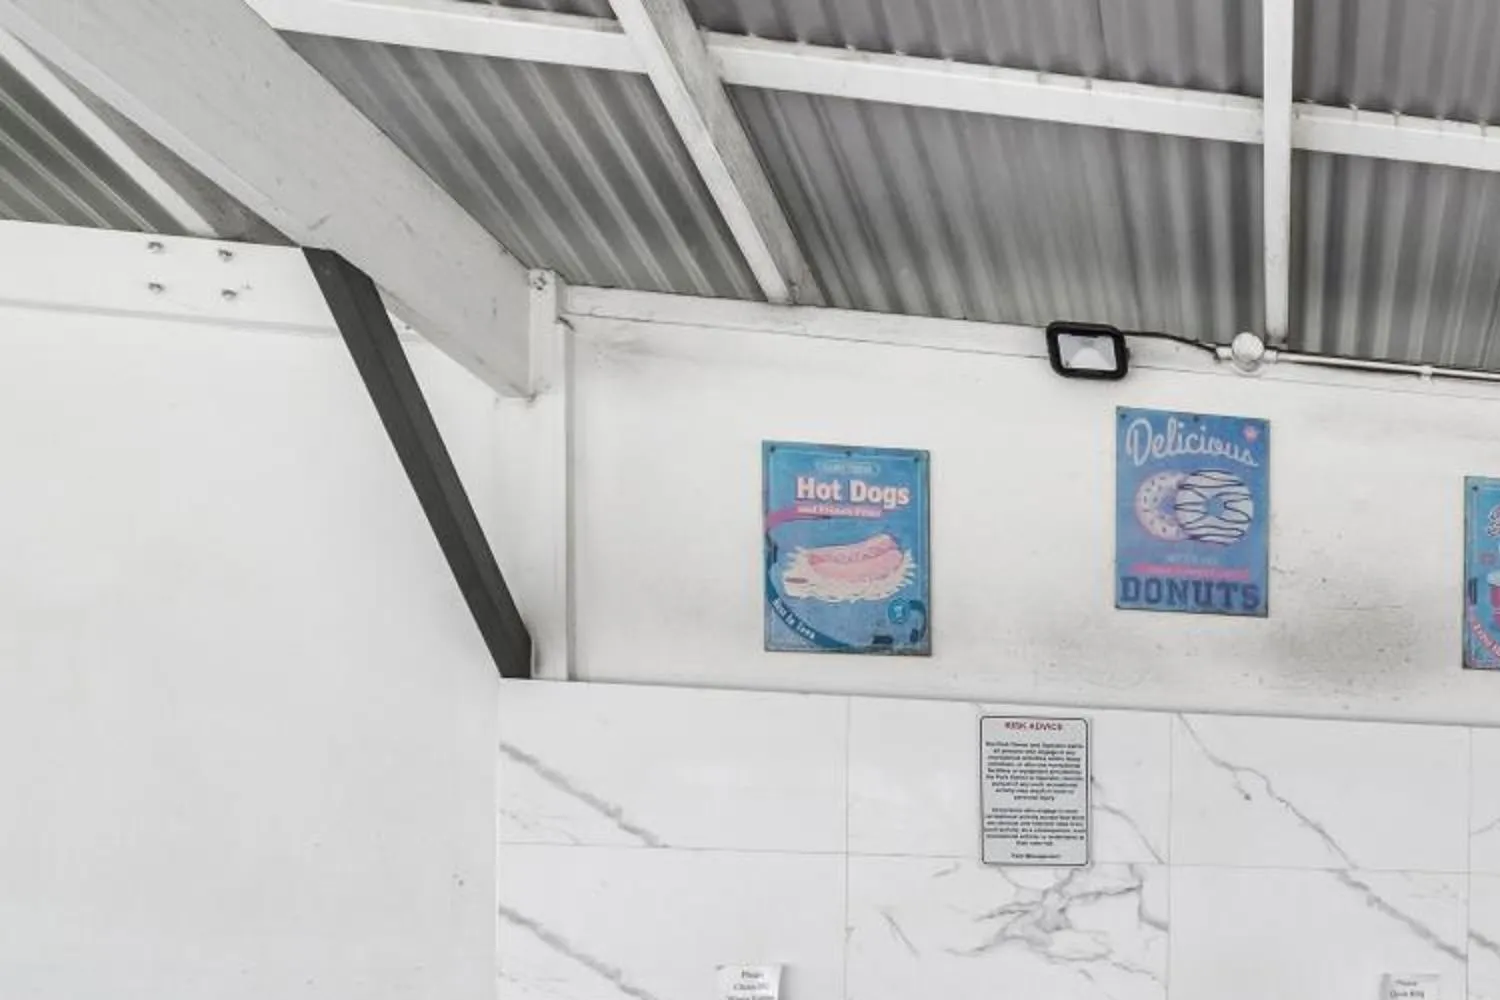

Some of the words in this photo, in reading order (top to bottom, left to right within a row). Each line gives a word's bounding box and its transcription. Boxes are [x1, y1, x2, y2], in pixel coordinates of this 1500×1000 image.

[1126, 418, 1259, 467] Delicious
[796, 475, 843, 501] Hot
[850, 479, 910, 509] Dogs
[1120, 576, 1261, 610] DONUTS
[1004, 721, 1026, 730] RISK
[1029, 721, 1063, 731] ADVICE
